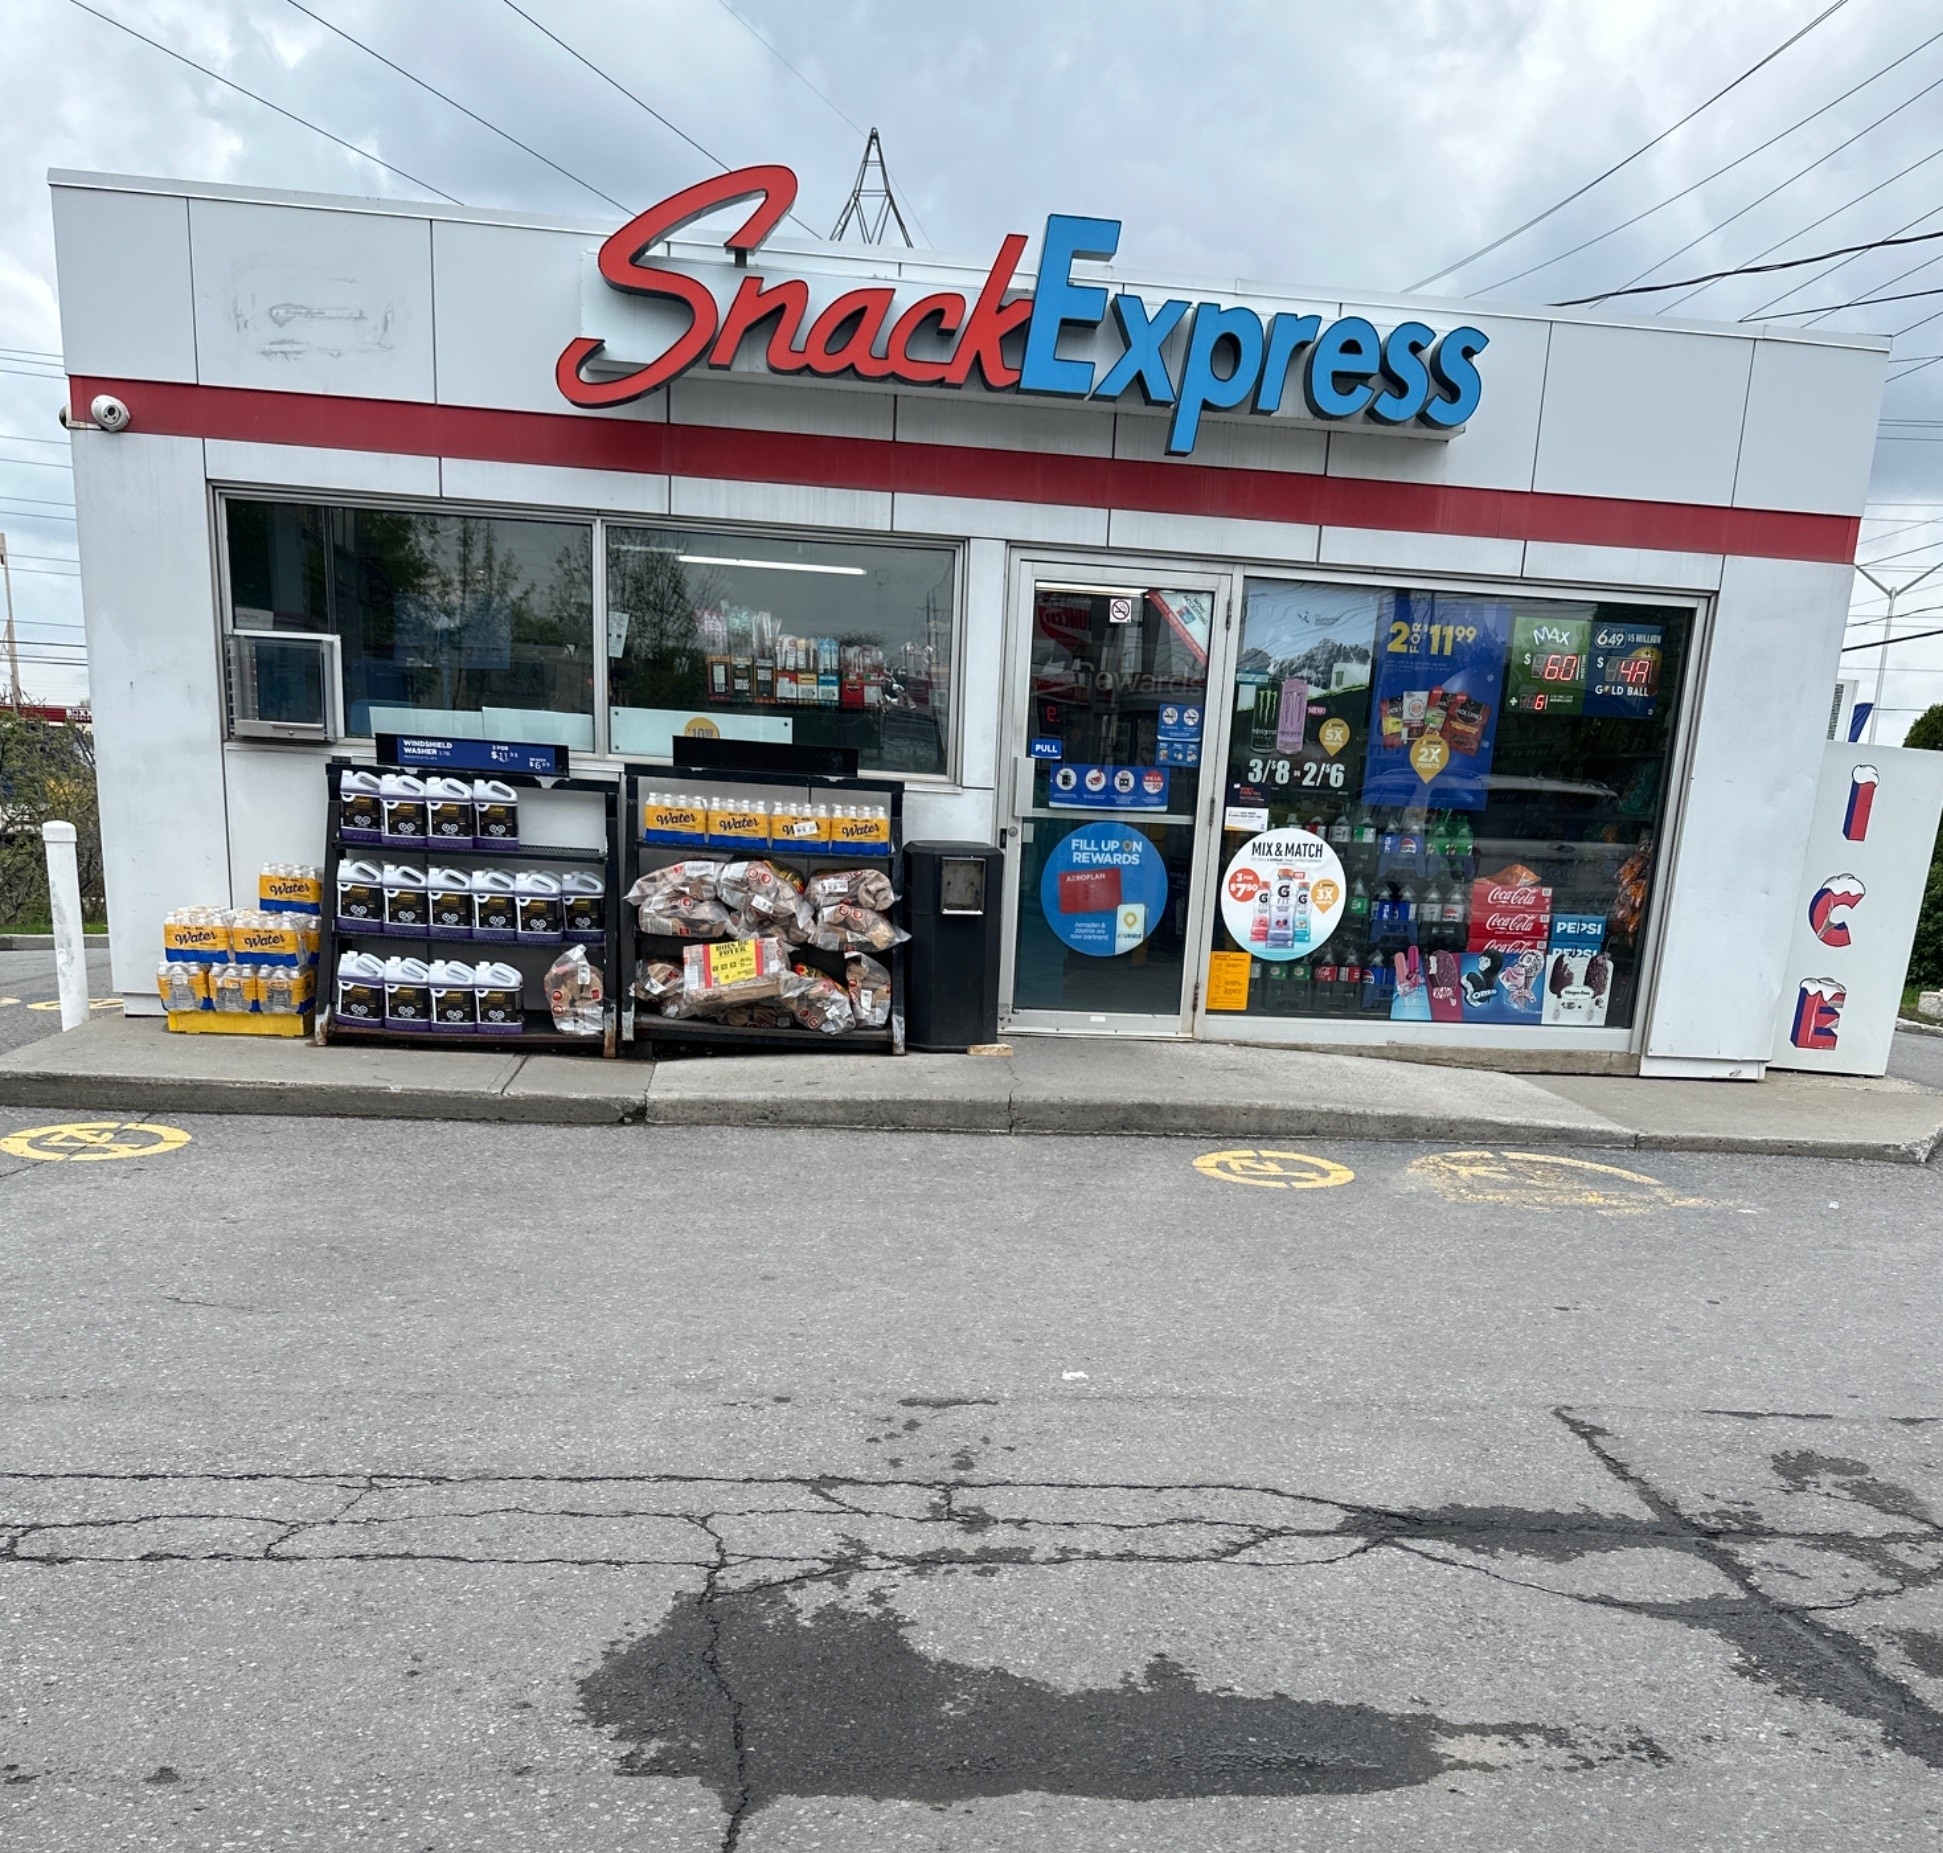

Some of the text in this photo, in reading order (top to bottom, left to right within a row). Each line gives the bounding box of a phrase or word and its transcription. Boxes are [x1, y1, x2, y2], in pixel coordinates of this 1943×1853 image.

[1387, 621, 1410, 653] 2
[1409, 622, 1422, 654] FOR
[1532, 626, 1571, 646] MAX
[1523, 653, 1532, 665] $
[1545, 655, 1577, 680] 60
[1596, 656, 1605, 668] $
[1627, 686, 1650, 697] BALL
[1325, 729, 1344, 742] 5X
[403, 740, 453, 749] WINDSHIELD
[403, 747, 437, 755] WASHER
[1035, 744, 1058, 753] PULL
[1418, 747, 1441, 763] 2X
[656, 812, 697, 825] Water
[719, 818, 760, 831] Water
[842, 823, 881, 838] Water
[1071, 839, 1143, 853] FILL UP ON
[1252, 842, 1323, 858] MIX & MATCH
[1072, 852, 1140, 865] REWARDS
[1065, 872, 1107, 883] AEROPLAN
[269, 882, 311, 896] Water
[1556, 921, 1603, 935] PEPSI
[174, 931, 218, 945] Water
[244, 934, 287, 949] Water
